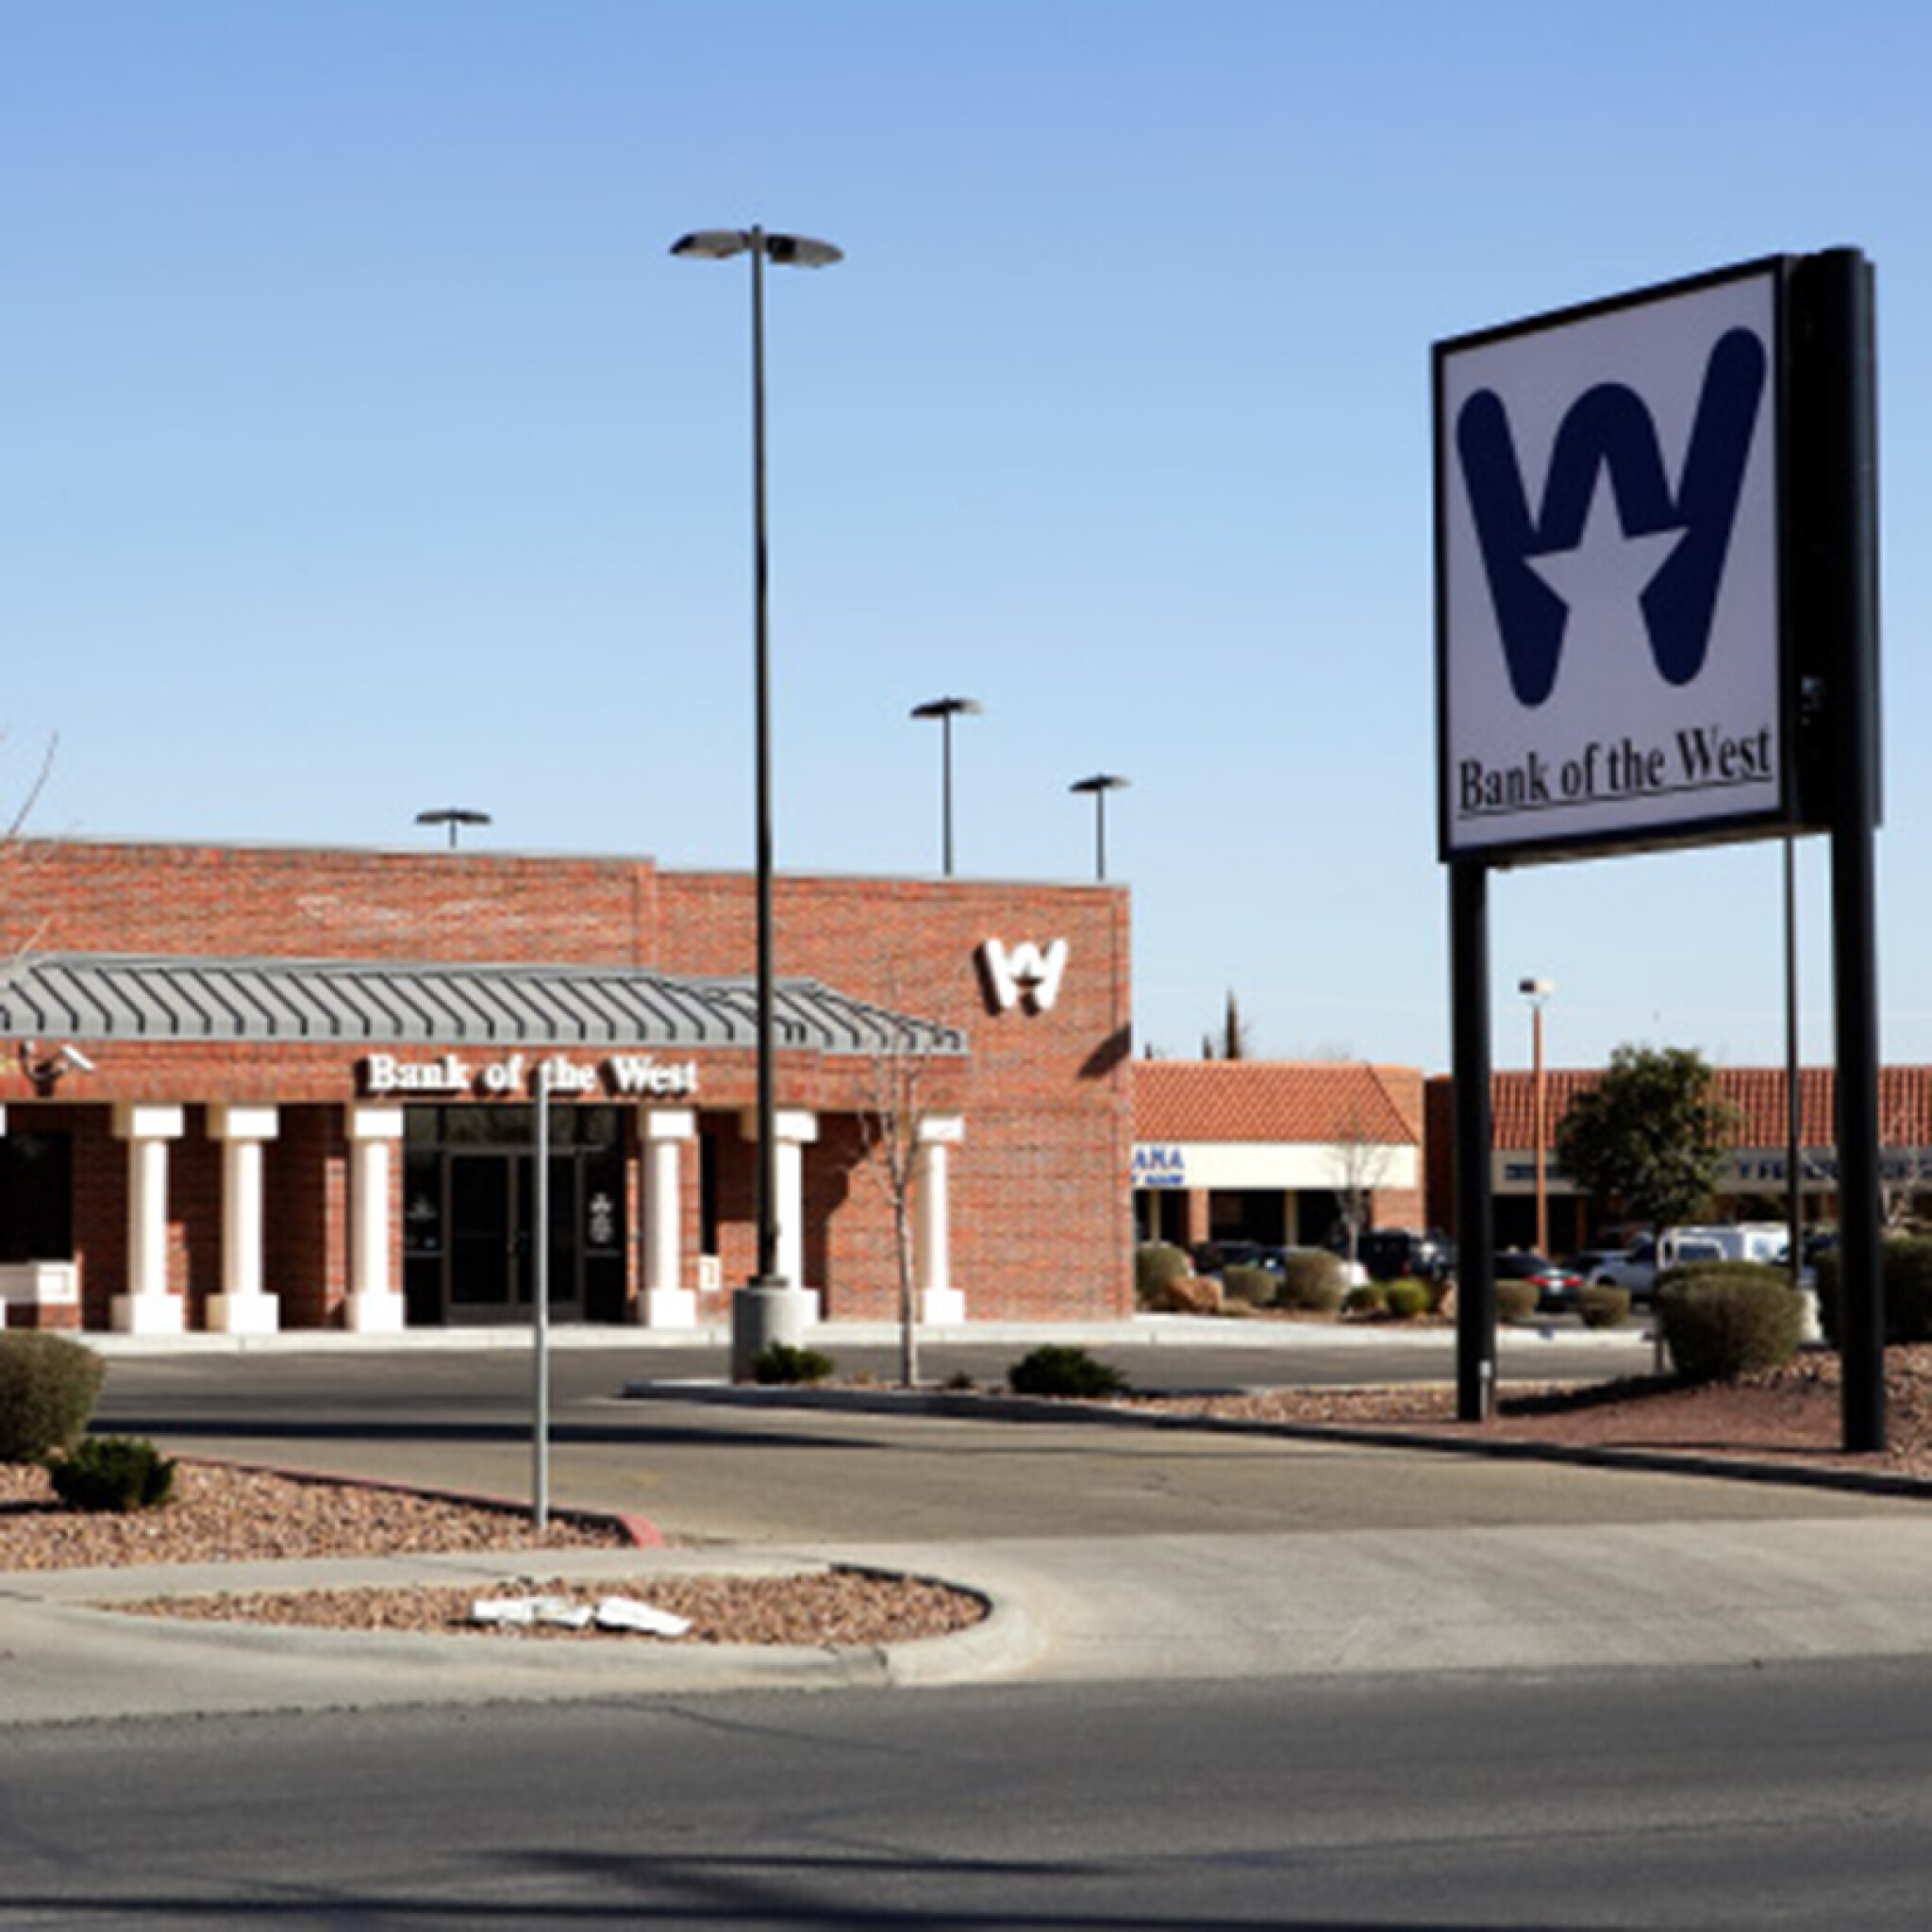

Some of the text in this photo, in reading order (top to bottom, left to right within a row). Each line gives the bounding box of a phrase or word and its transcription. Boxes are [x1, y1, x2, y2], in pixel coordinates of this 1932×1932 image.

[1458, 724, 1770, 812] Bank of the West
[369, 1053, 471, 1090] Bank
[484, 1053, 524, 1090] of
[611, 1055, 698, 1092] West
